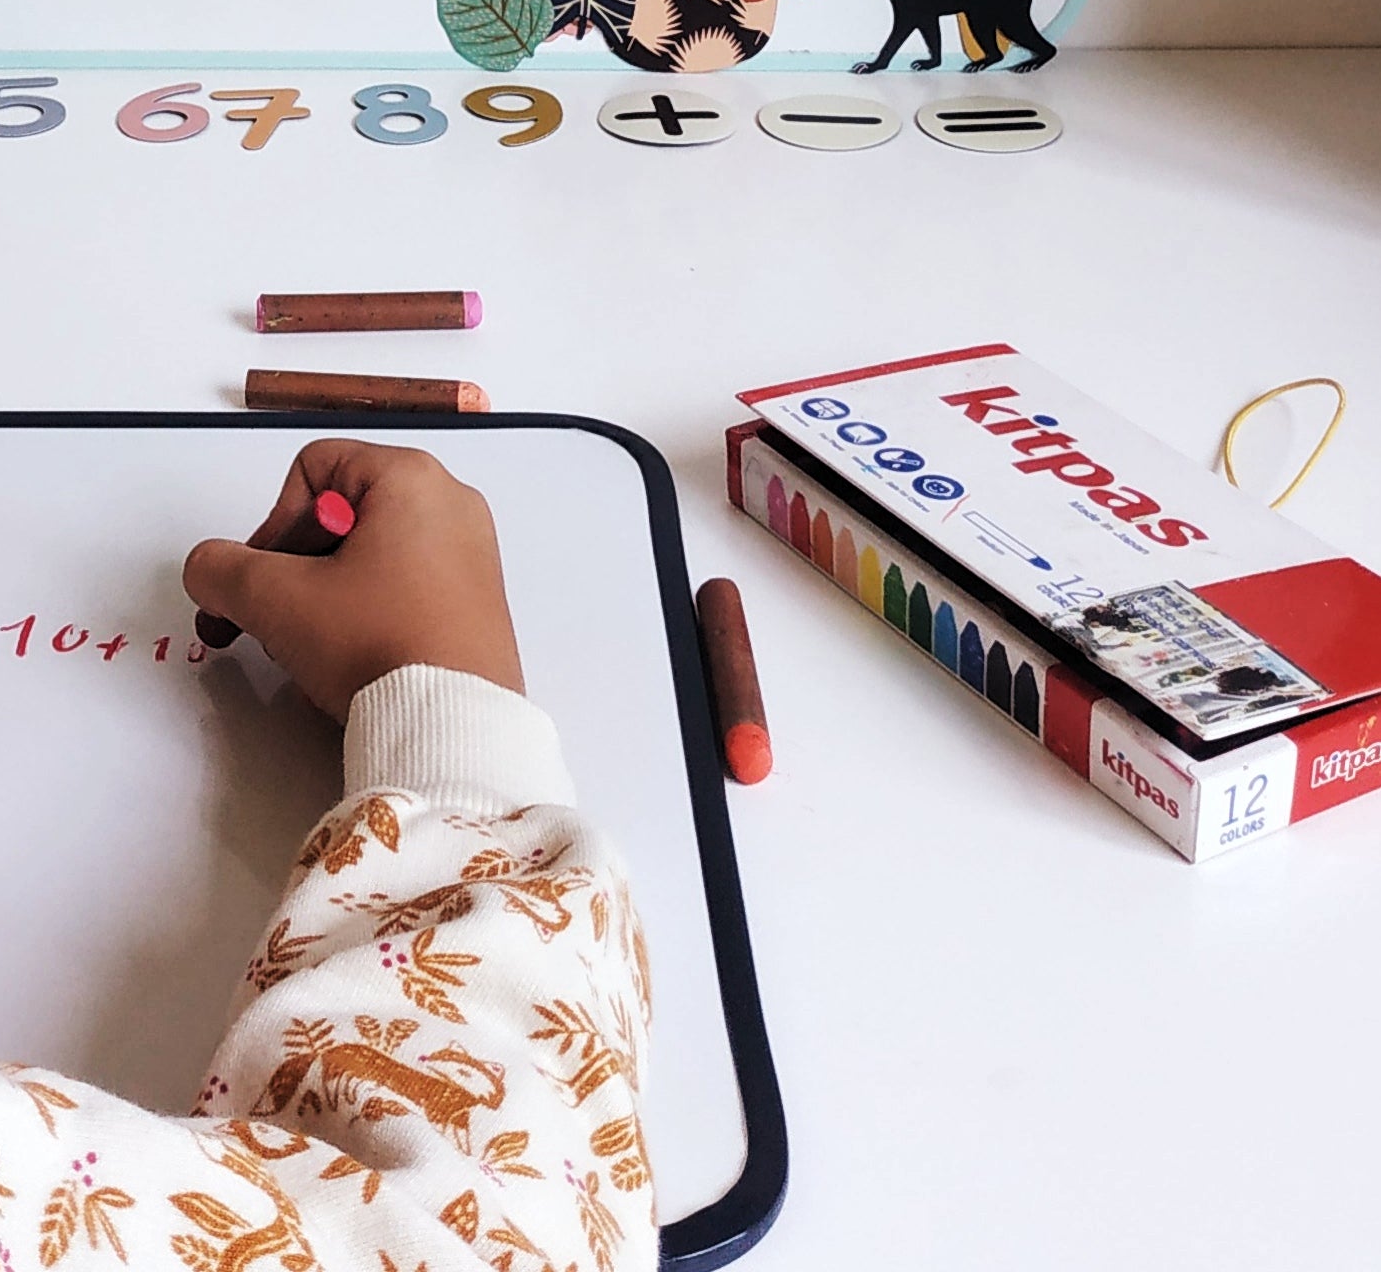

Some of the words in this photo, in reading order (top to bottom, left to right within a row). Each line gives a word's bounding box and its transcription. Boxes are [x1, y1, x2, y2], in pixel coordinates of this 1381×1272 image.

[938, 385, 1210, 548] kitpas
[1069, 501, 1101, 522] Made
[1113, 531, 1150, 556] Japan
[1049, 574, 1105, 604] 12
[1101, 738, 1181, 820] kitpas
[1221, 773, 1269, 828] 12
[1219, 817, 1265, 846] COLORS
